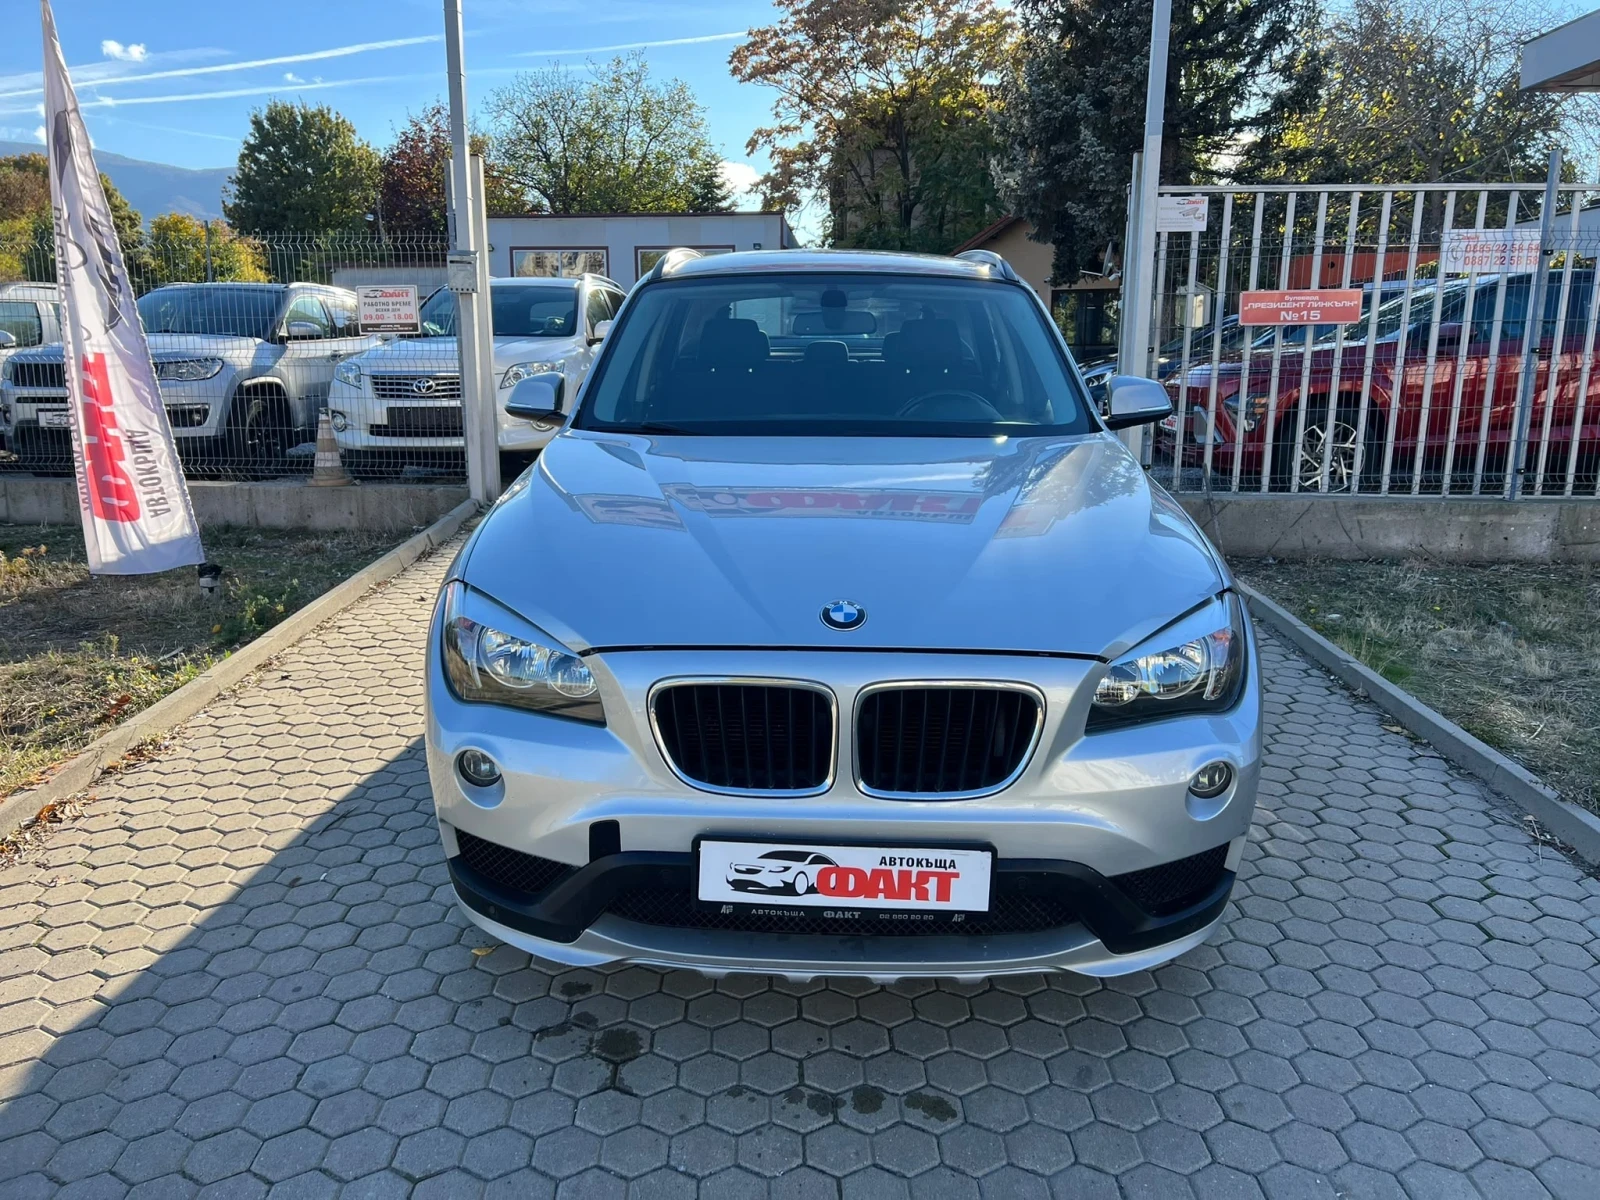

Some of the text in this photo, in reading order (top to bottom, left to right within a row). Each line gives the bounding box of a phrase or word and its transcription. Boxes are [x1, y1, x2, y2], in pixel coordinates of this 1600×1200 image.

[1494, 243, 1508, 254] 22
[1464, 255, 1539, 266] 0887 22 58 58
[363, 313, 385, 321] 09.00
[879, 855, 957, 870] АВТОКЪЩА
[816, 866, 960, 902] ФАКТ
[823, 910, 861, 919] ФАКТ
